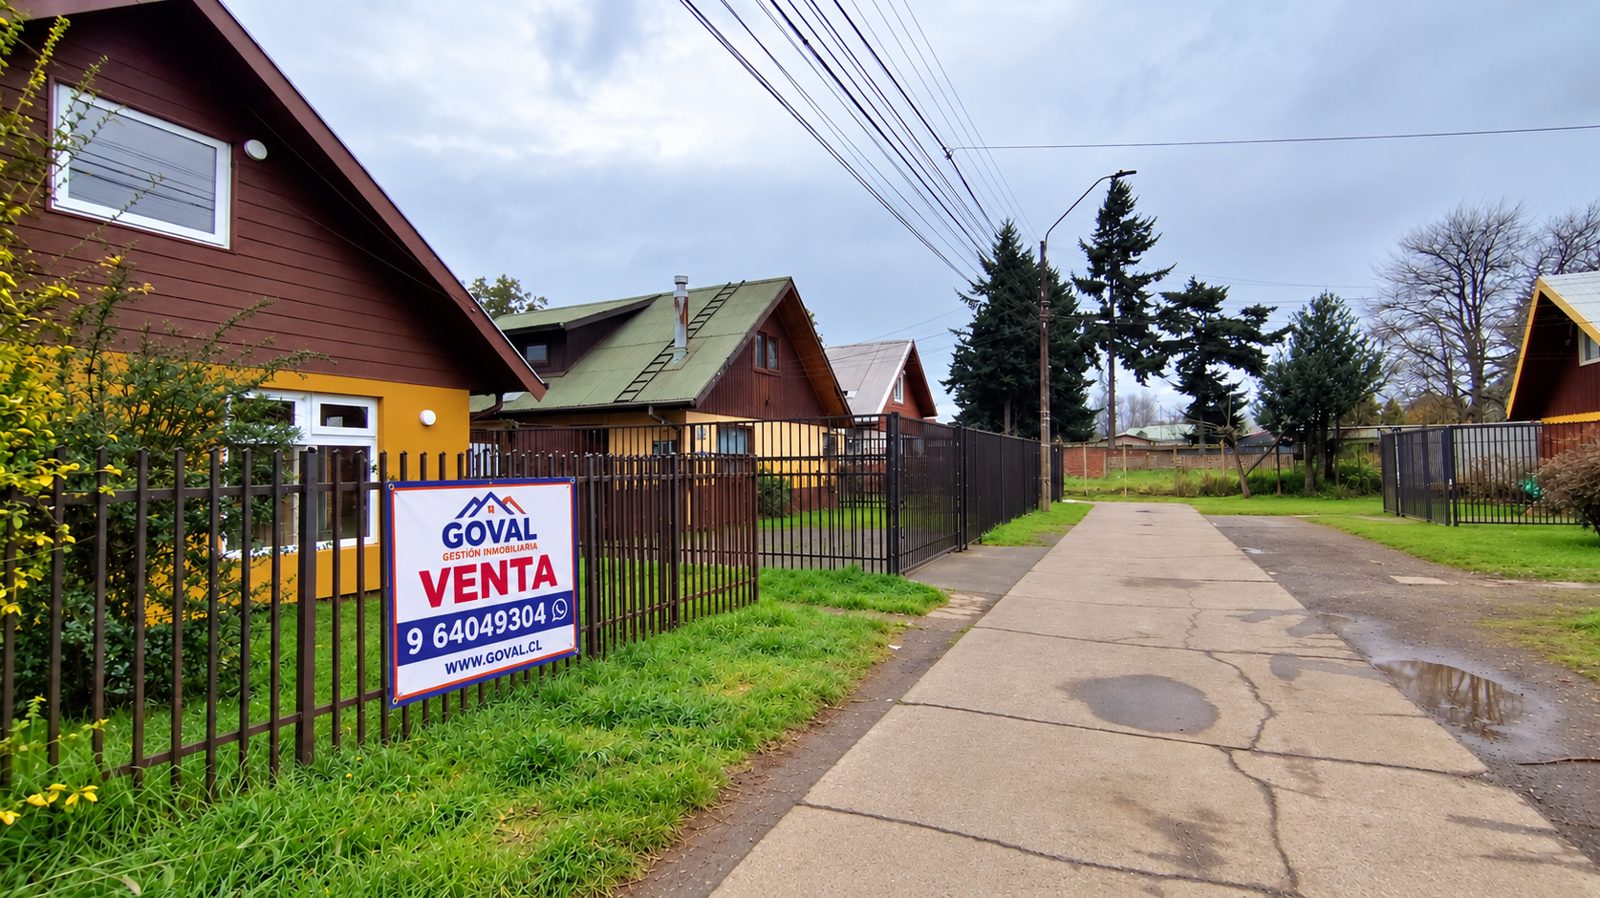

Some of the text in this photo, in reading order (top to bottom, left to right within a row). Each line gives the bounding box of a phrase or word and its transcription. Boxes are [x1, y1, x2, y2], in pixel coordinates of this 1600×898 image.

[442, 518, 537, 549] GOVAL
[483, 542, 538, 556] INMOBILIARIA
[419, 554, 558, 608] VENTA
[406, 602, 546, 655] 9 64049304
[445, 640, 542, 674] WWW.GOVAL.CL
